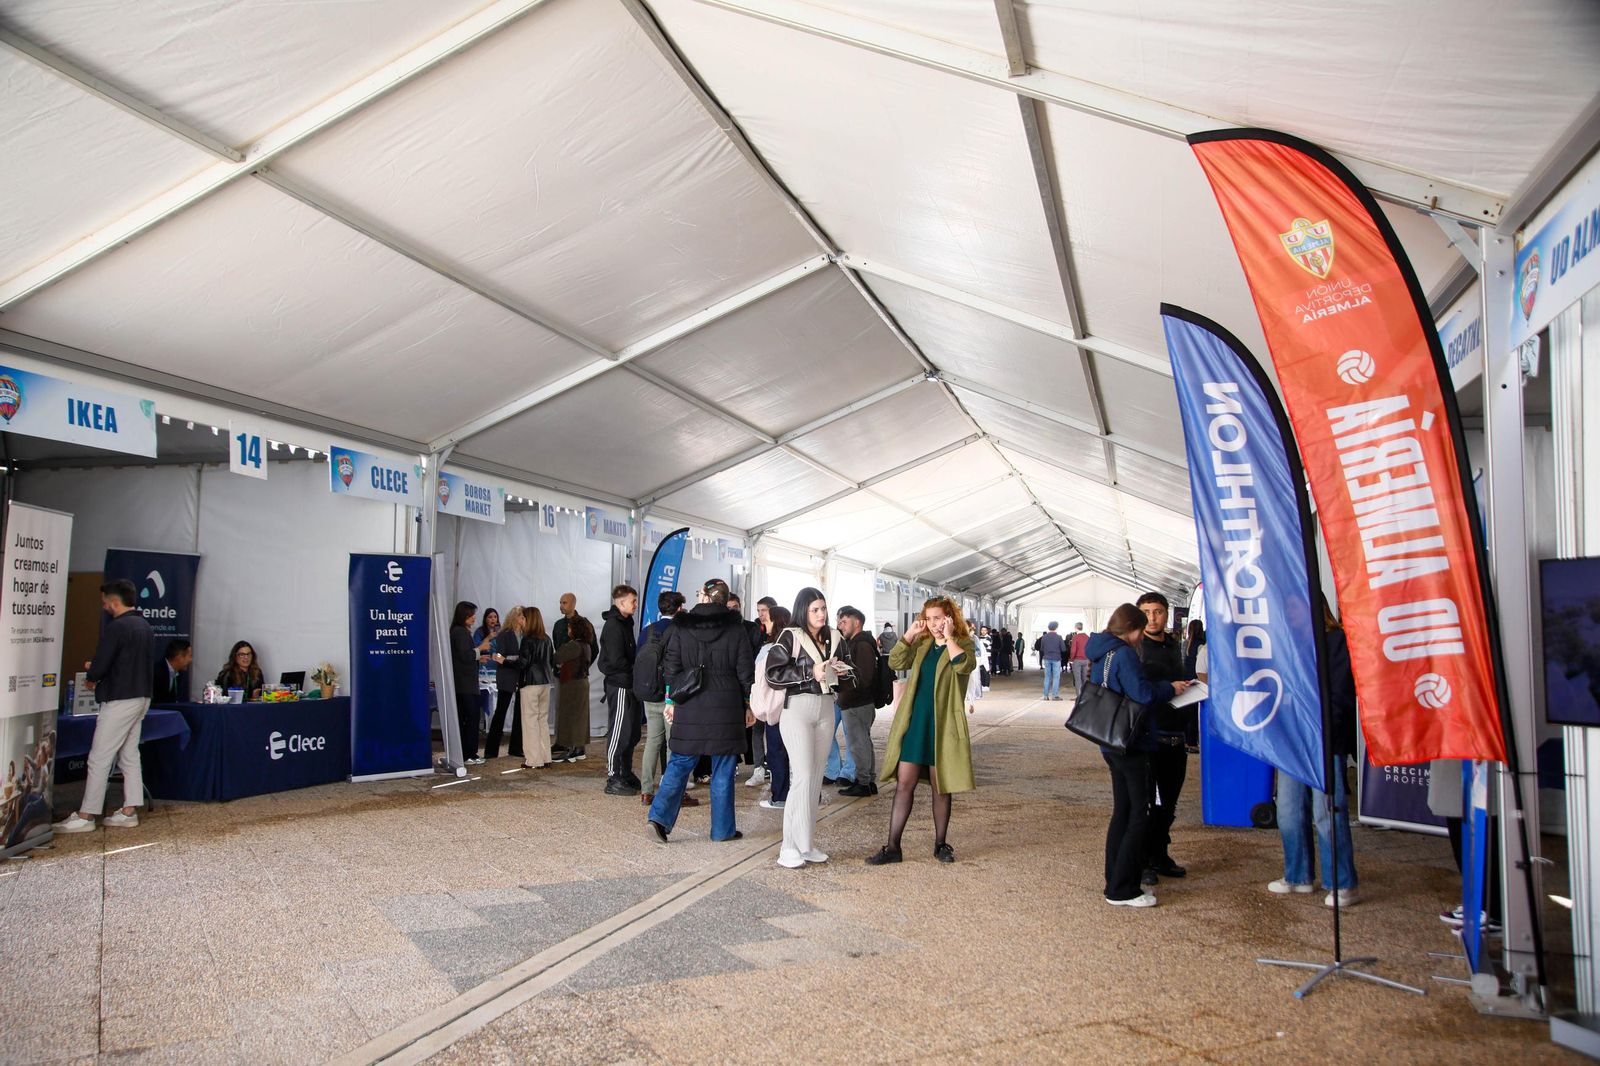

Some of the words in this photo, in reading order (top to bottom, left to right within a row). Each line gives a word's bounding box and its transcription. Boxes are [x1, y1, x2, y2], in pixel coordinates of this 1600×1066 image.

[1551, 235, 1570, 286] UD
[68, 398, 118, 433] IKEA
[236, 432, 262, 469] 14
[371, 465, 409, 494] CLECE
[464, 483, 491, 502] BOROSA
[465, 499, 491, 516] MARKET
[542, 504, 554, 528] 16
[603, 519, 627, 538] MAKITO
[15, 533, 44, 550] Juntos
[14, 558, 49, 573] creamos
[50, 560, 59, 573] el
[13, 577, 39, 597] hogar
[41, 580, 49, 594] de
[380, 584, 403, 594] Clece
[12, 601, 26, 615] tus
[27, 601, 55, 616] sueños
[136, 606, 177, 619] ende
[370, 609, 385, 620] Un
[387, 609, 413, 624] lugar
[376, 629, 398, 640] para
[400, 626, 407, 636] ti
[289, 735, 326, 752] Clece
